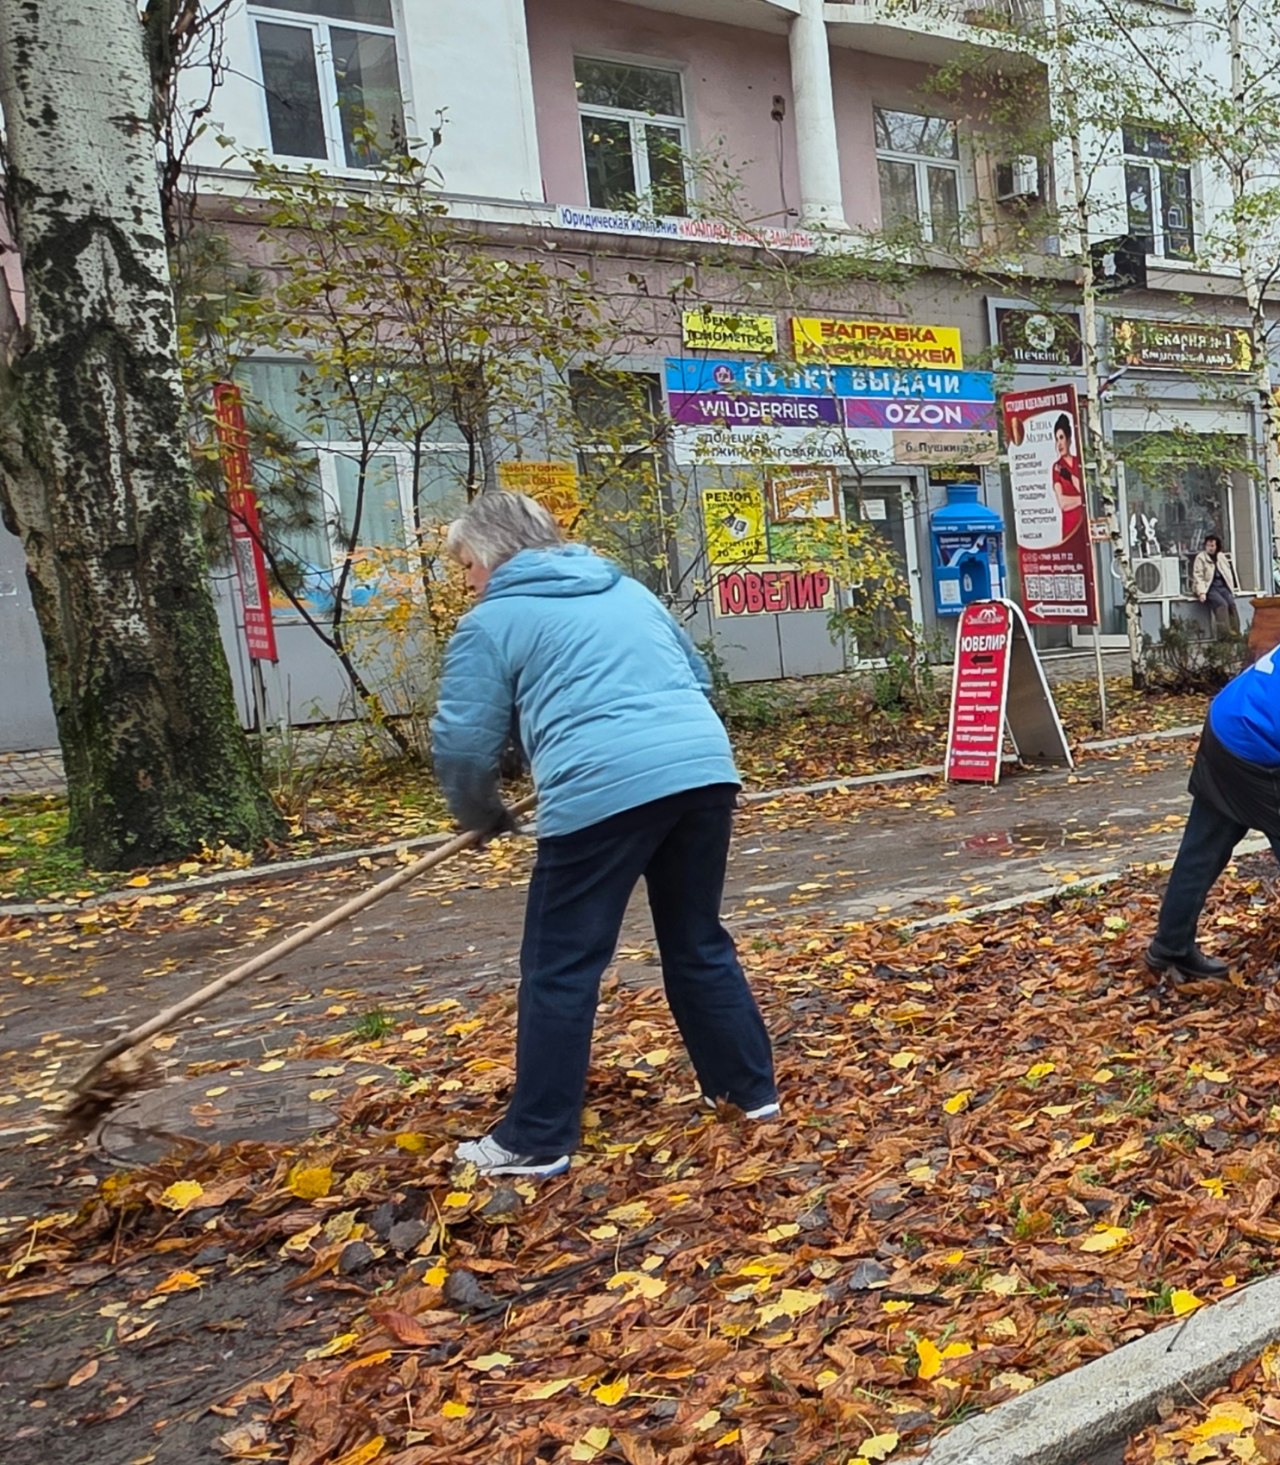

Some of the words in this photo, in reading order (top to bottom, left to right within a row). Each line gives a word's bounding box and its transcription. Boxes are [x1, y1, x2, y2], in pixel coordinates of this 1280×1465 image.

[562, 208, 629, 230] Юридическая
[820, 322, 937, 343] ЗАПРАВКА
[744, 365, 837, 390] ПУНКТ
[852, 370, 960, 395] ВЫДАЧИ
[699, 400, 819, 420] WILDBERRIES
[885, 402, 962, 424] OZON
[718, 569, 830, 615] ЮВЕЛИР
[961, 634, 1006, 652] ЮВЕЛИР
